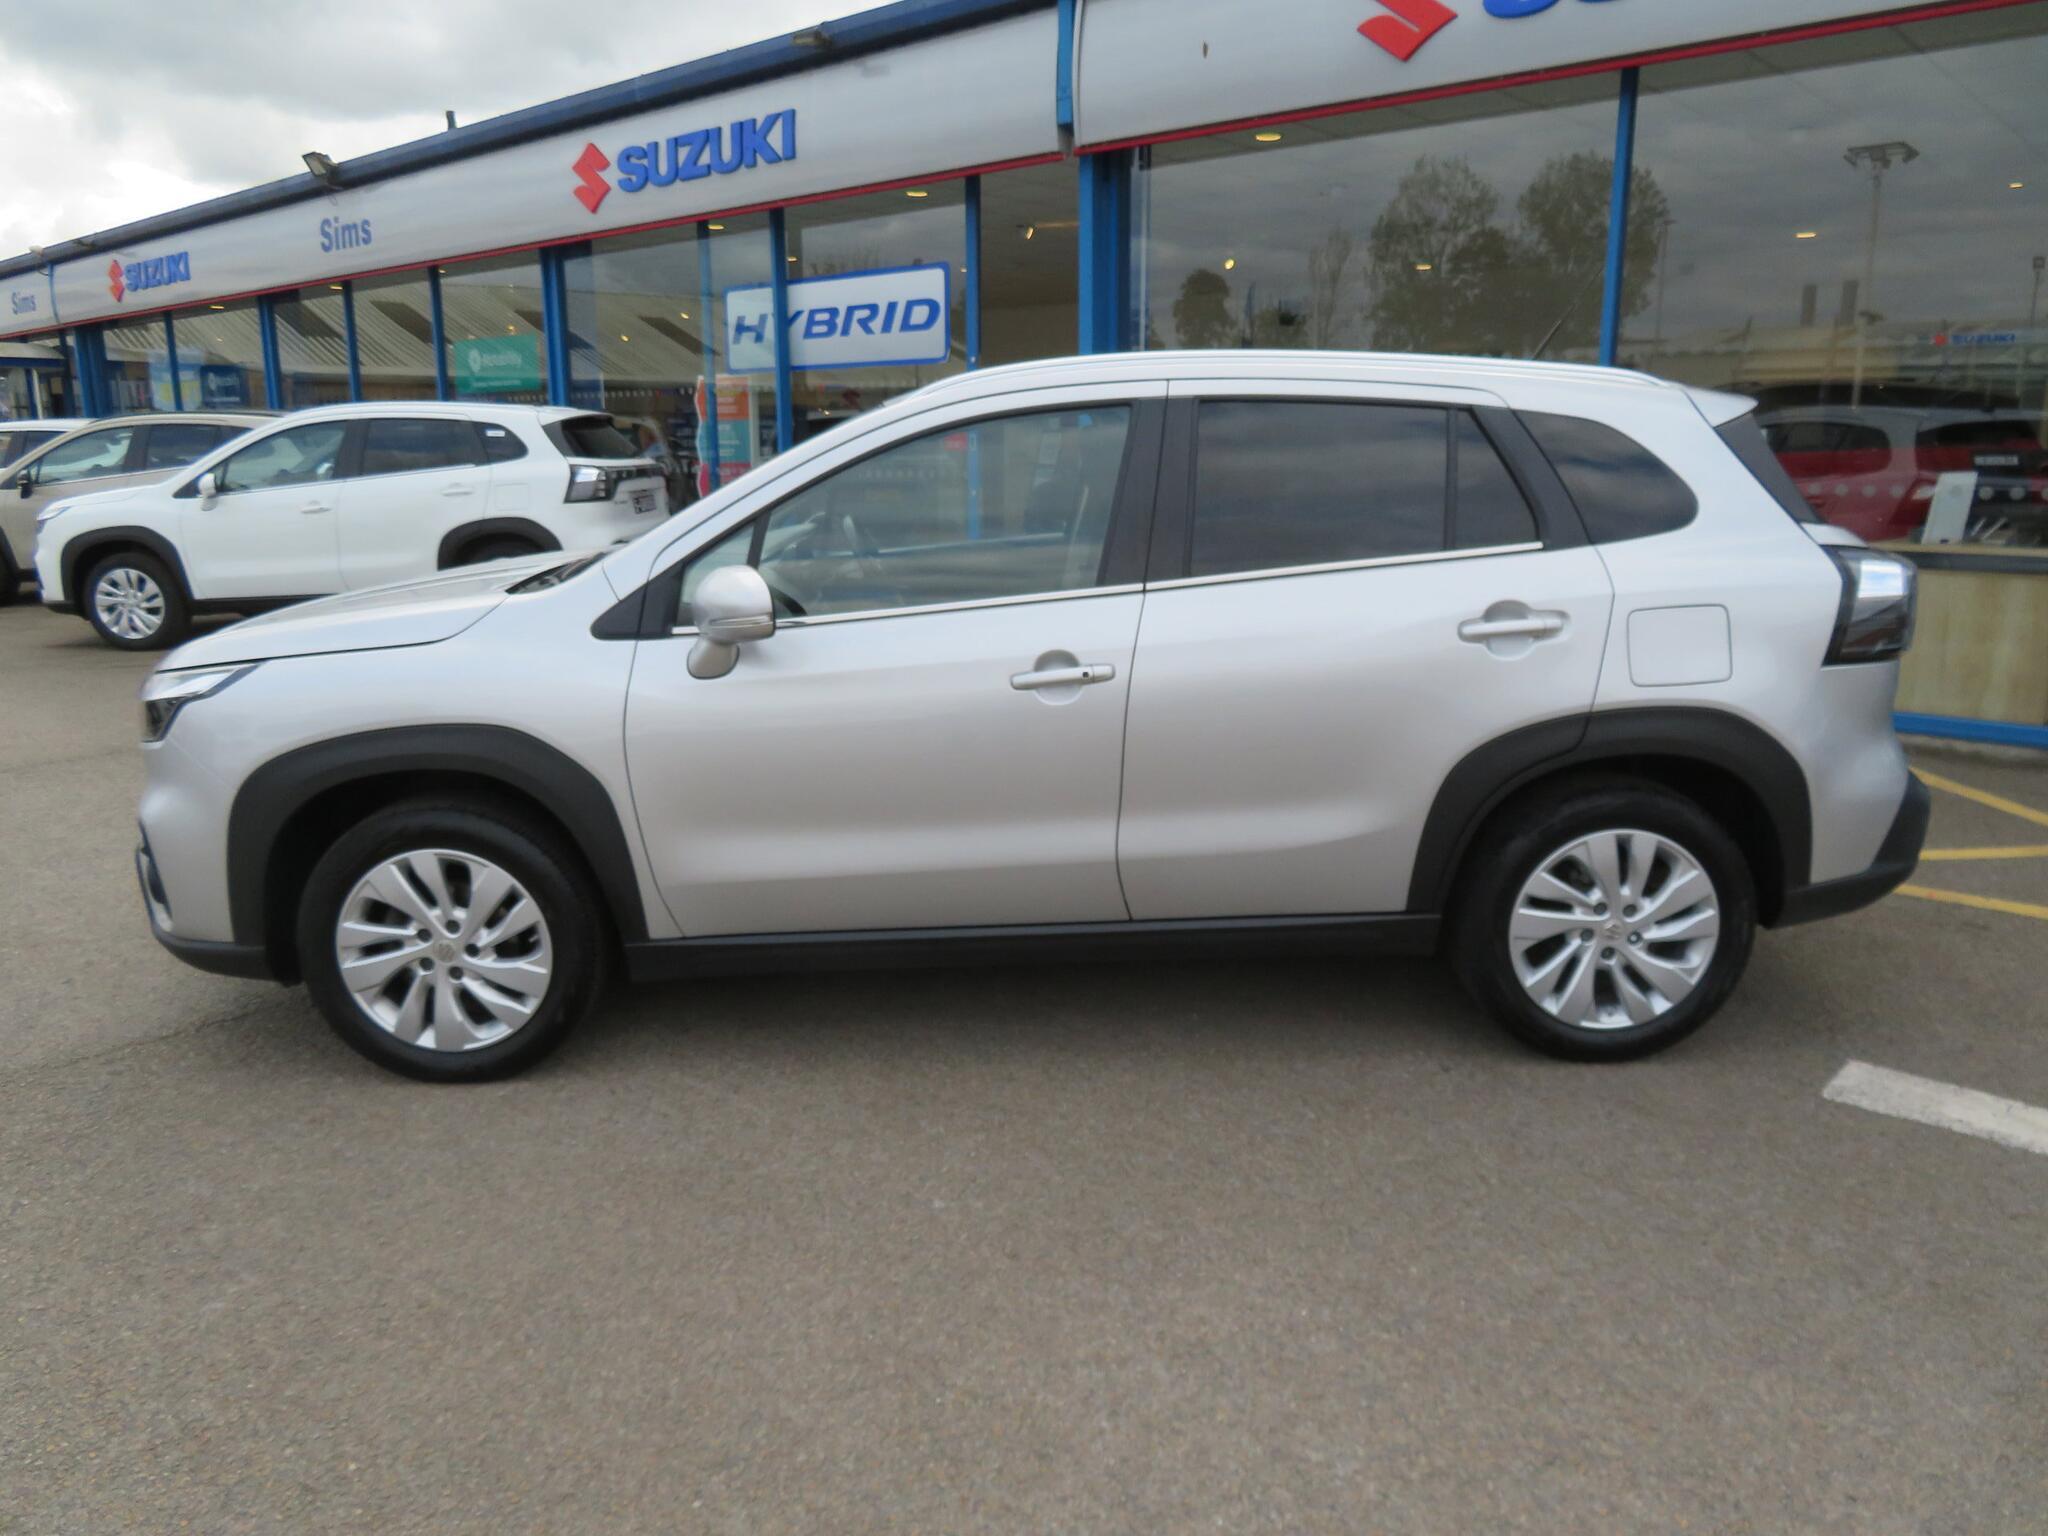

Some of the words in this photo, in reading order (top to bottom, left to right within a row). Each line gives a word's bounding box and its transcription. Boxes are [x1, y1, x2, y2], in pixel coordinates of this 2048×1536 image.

[617, 108, 796, 192] SUZUKI
[320, 216, 372, 253] Sims
[125, 251, 191, 292] SUZUKI
